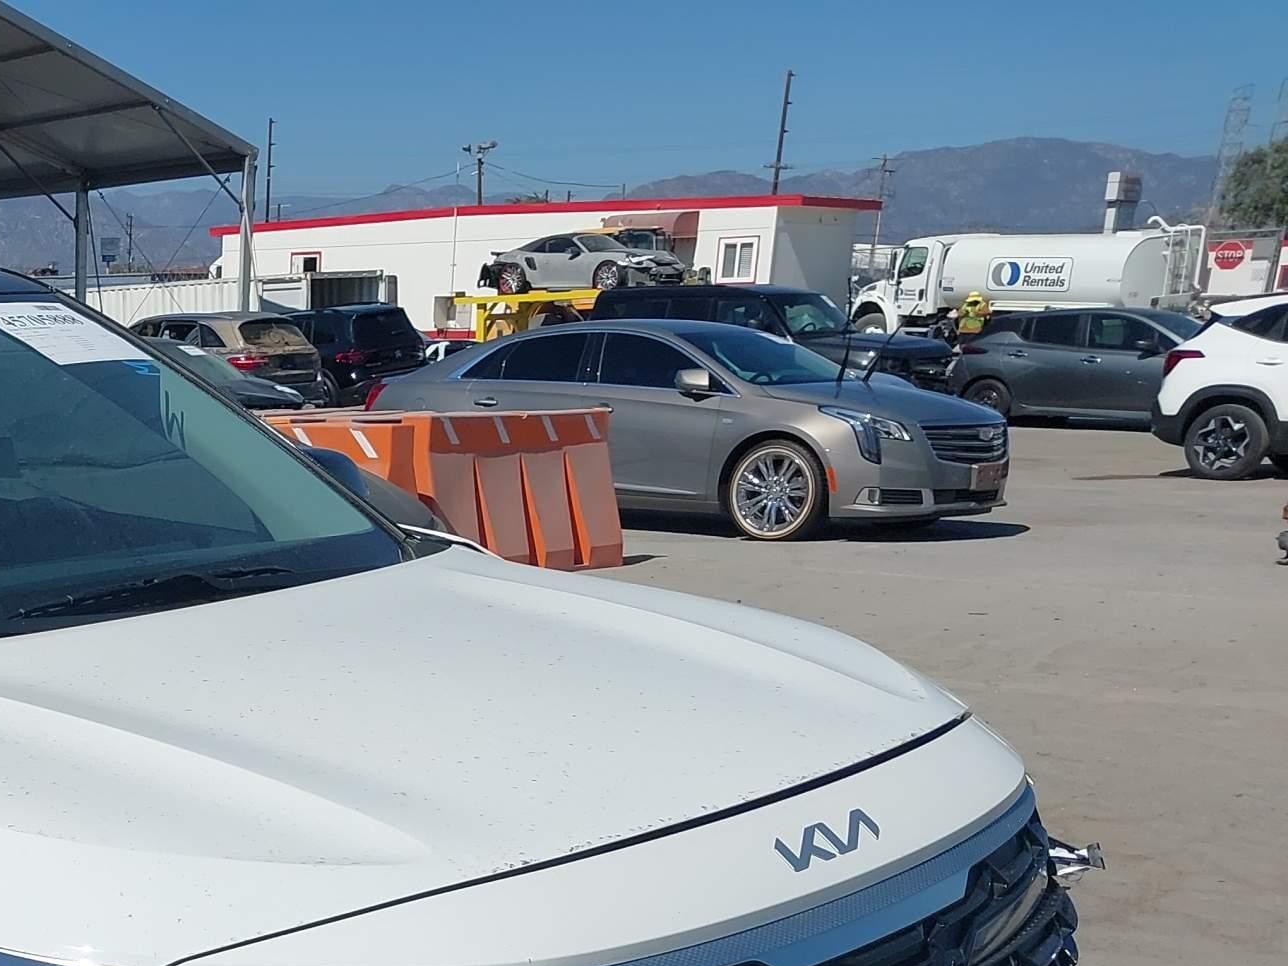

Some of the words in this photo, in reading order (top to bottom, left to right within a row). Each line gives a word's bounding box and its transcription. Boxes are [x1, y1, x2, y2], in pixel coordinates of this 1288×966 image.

[1216, 250, 1243, 261] STOP
[1024, 262, 1065, 274] United
[1022, 275, 1065, 287] Rentals
[0, 314, 84, 327] 45705888
[774, 808, 880, 872] KIA
